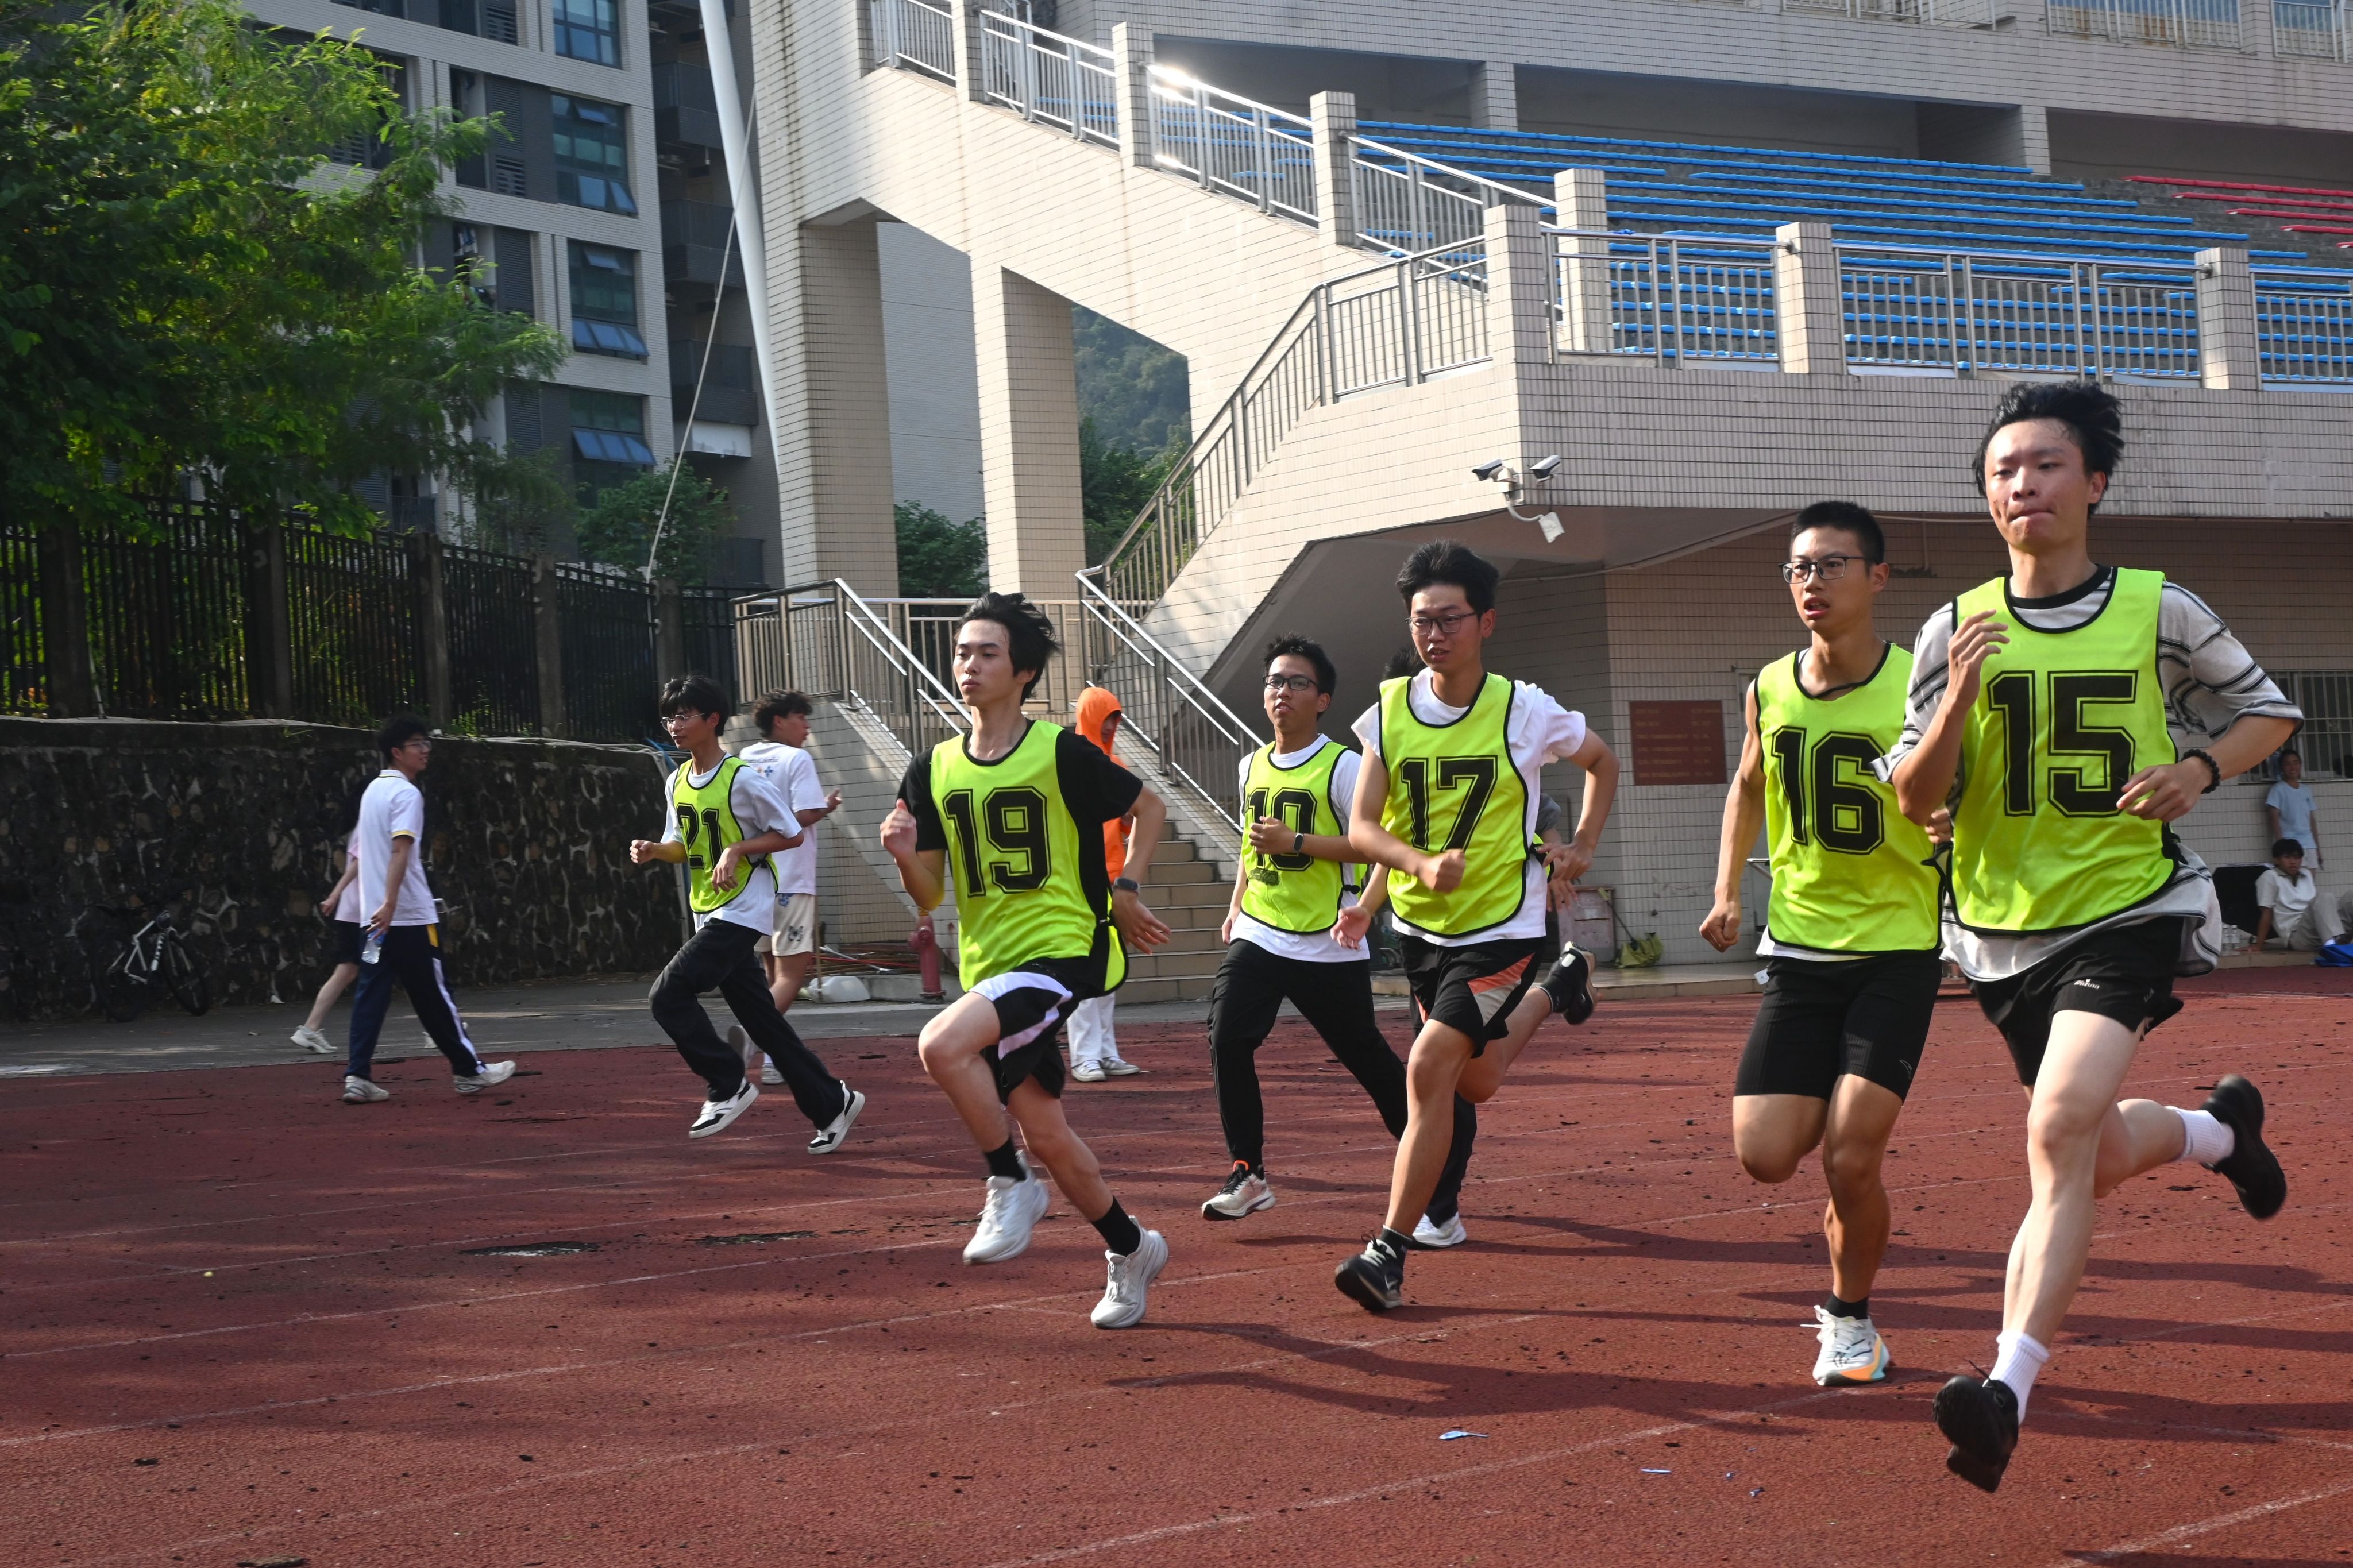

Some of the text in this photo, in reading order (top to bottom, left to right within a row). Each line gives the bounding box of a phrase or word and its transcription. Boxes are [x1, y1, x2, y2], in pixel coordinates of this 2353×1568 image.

[1771, 725, 1885, 855] 16
[1987, 670, 2138, 817] 15
[676, 802, 723, 872] 21
[943, 786, 1051, 897] 19
[1249, 787, 1317, 871] 10
[1399, 755, 1498, 852] 17
